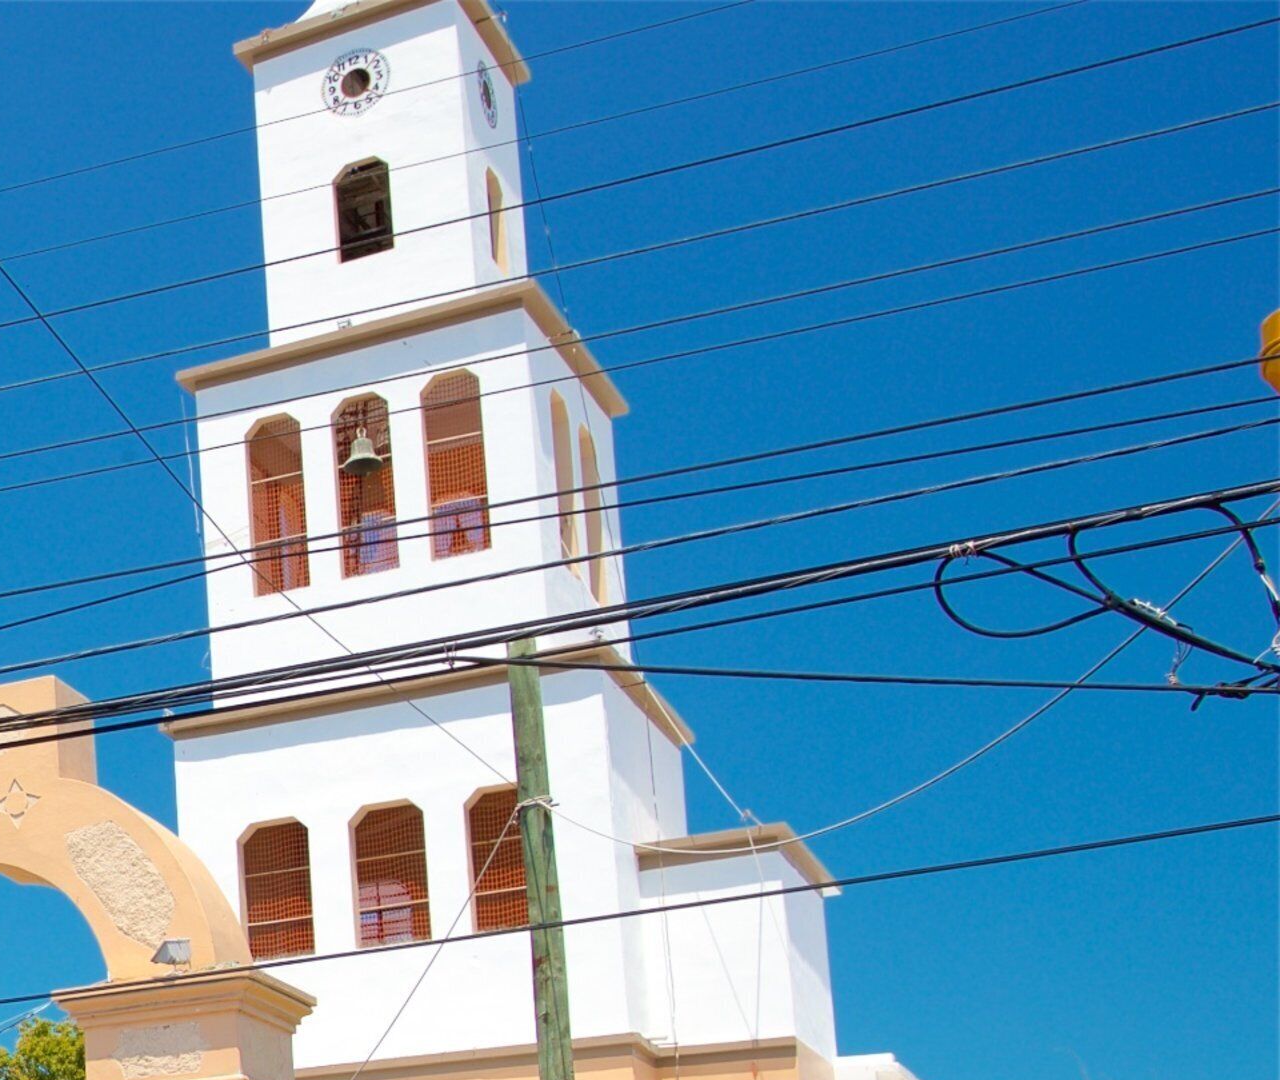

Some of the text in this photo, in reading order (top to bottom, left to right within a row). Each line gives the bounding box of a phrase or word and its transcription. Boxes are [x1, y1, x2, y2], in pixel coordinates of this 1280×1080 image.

[348, 55, 360, 66] 12
[363, 54, 368, 63] 1
[337, 62, 345, 71] 11
[374, 60, 380, 69] 2
[327, 73, 339, 84] 10
[375, 70, 383, 80] 3
[329, 86, 336, 95] 9
